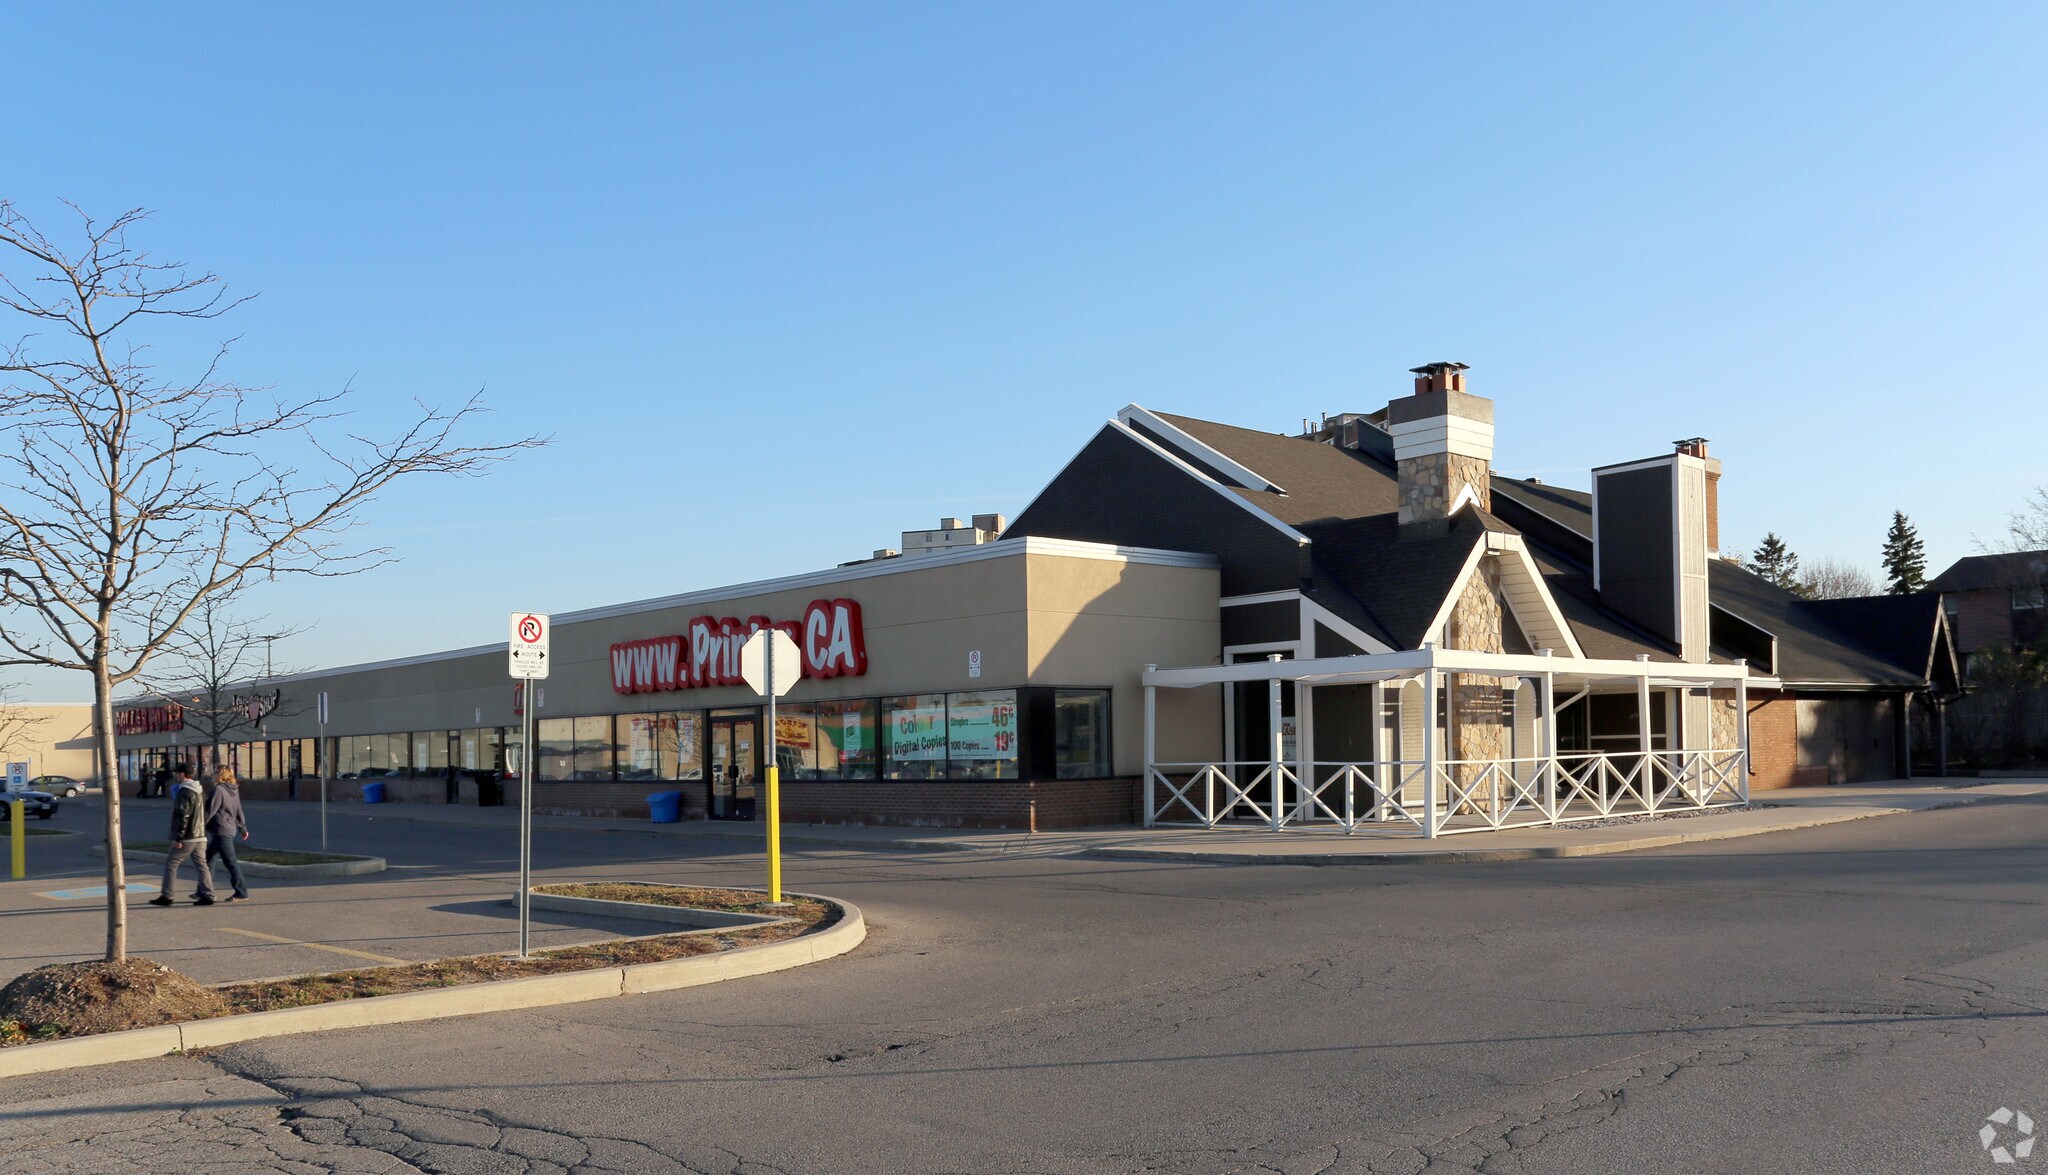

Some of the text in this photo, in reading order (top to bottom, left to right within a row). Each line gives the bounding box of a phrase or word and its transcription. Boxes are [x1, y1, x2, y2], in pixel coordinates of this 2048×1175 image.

[894, 735, 947, 757] Digital Copies
[950, 741, 961, 750] 100
[962, 741, 980, 751] Copies
